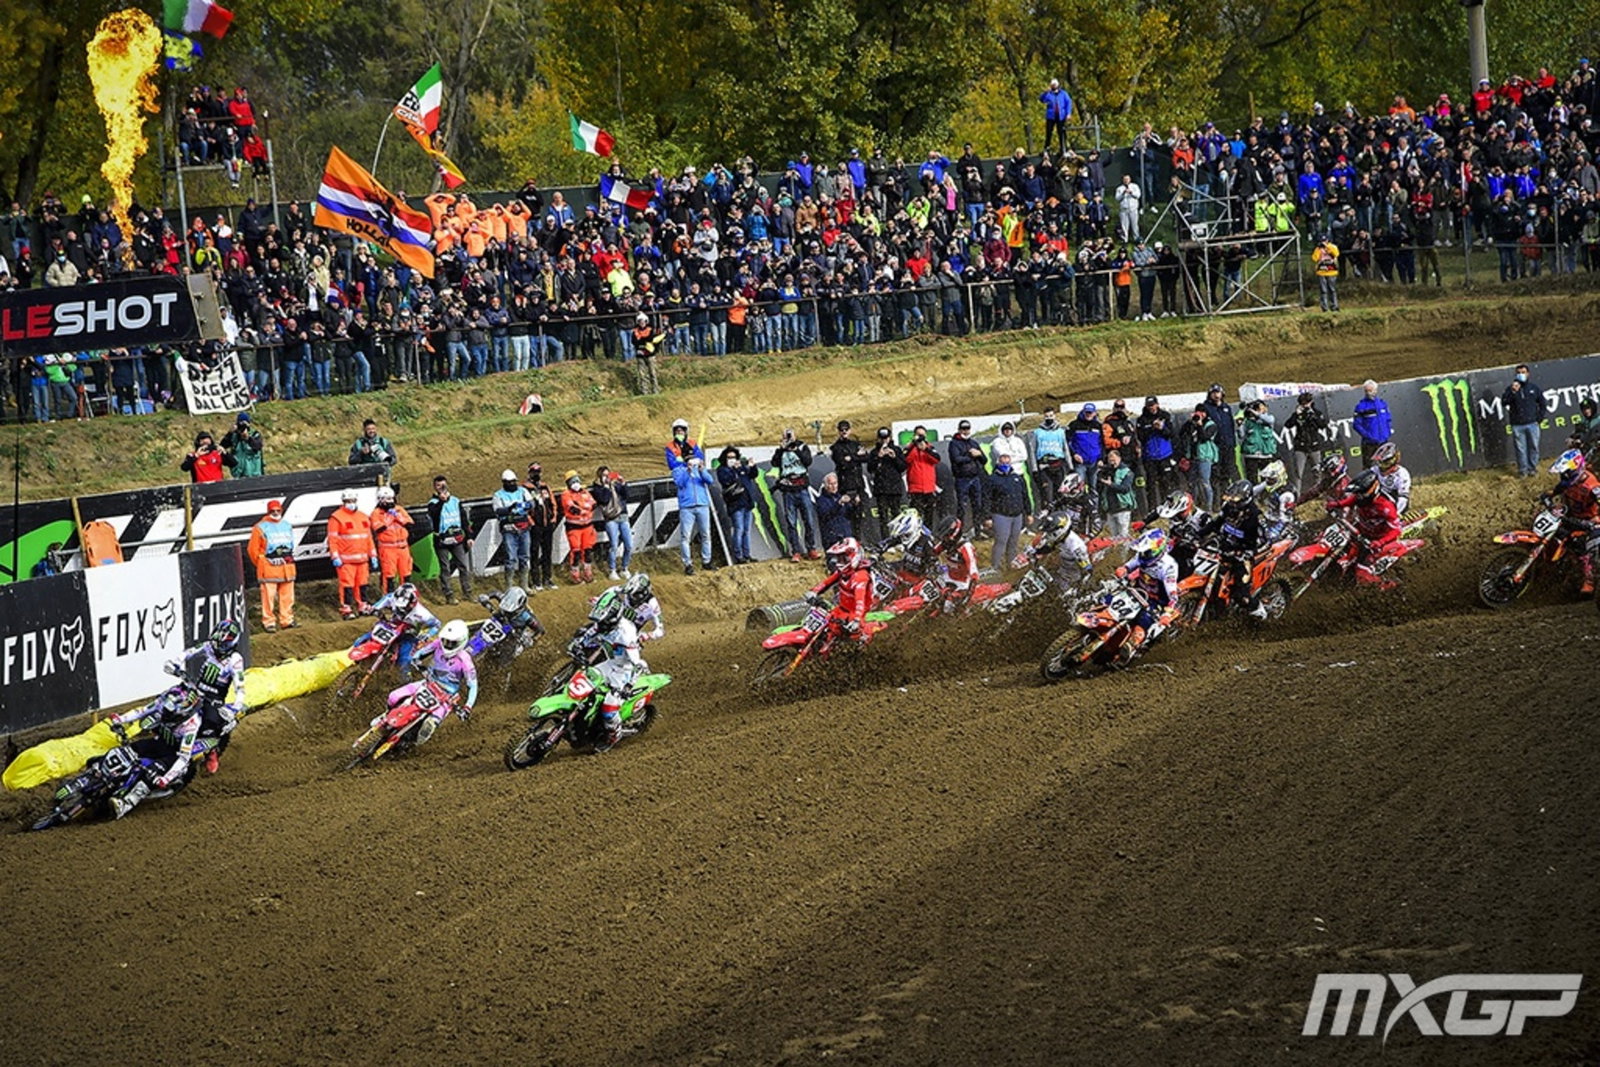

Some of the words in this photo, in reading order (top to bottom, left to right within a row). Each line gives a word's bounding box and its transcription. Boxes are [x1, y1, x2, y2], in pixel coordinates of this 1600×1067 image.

[2, 292, 178, 341] LESHOT
[1535, 517, 1553, 532] 61
[1194, 556, 1218, 573] 77
[1111, 599, 1133, 617] 84
[97, 608, 148, 661] FOX
[482, 622, 503, 641] 92
[3, 628, 56, 686] FOX
